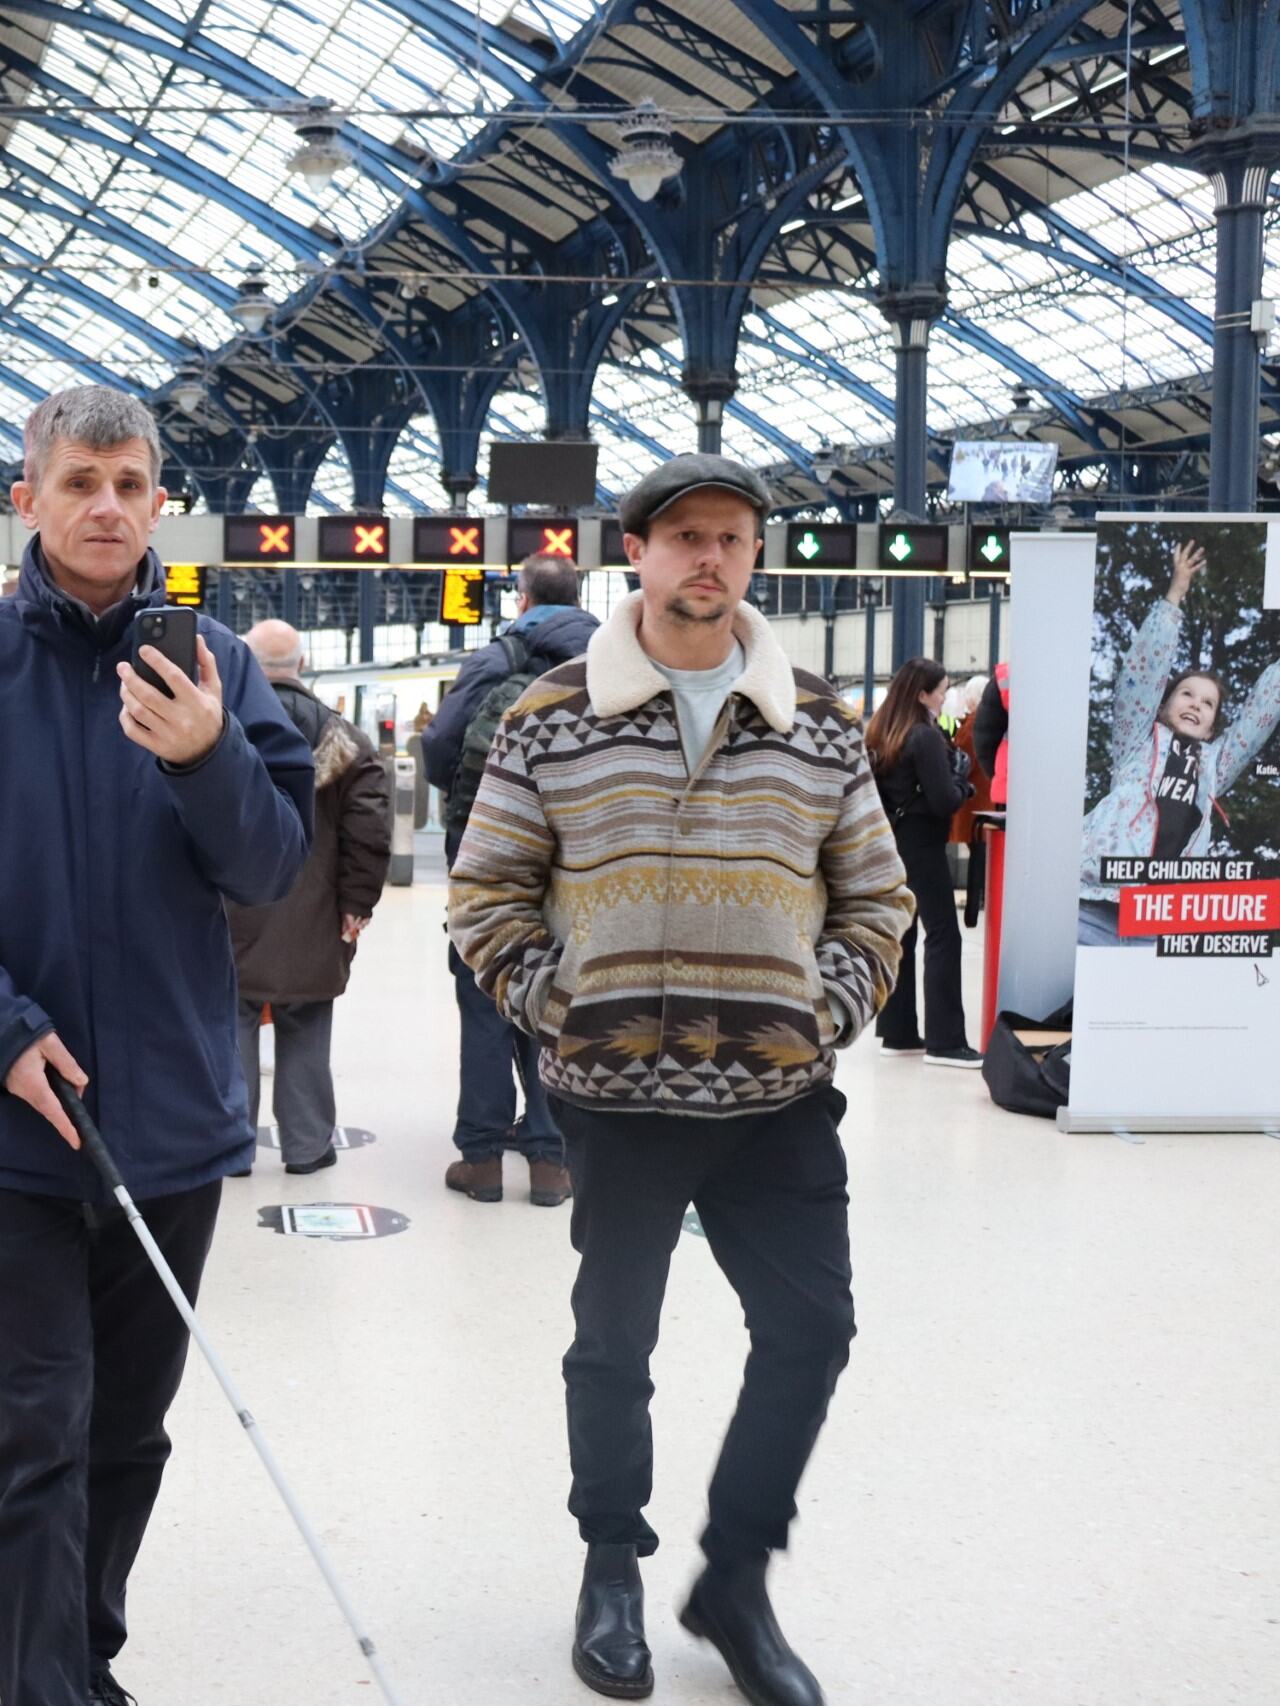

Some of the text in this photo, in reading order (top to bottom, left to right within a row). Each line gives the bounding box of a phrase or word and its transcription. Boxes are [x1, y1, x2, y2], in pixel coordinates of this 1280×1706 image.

[1256, 764, 1280, 776] Katie,
[1106, 860, 1254, 880] HELP CHILDREN GET
[1133, 894, 1268, 922] THE FUTURE
[1162, 935, 1269, 954] THEY DESERVE
